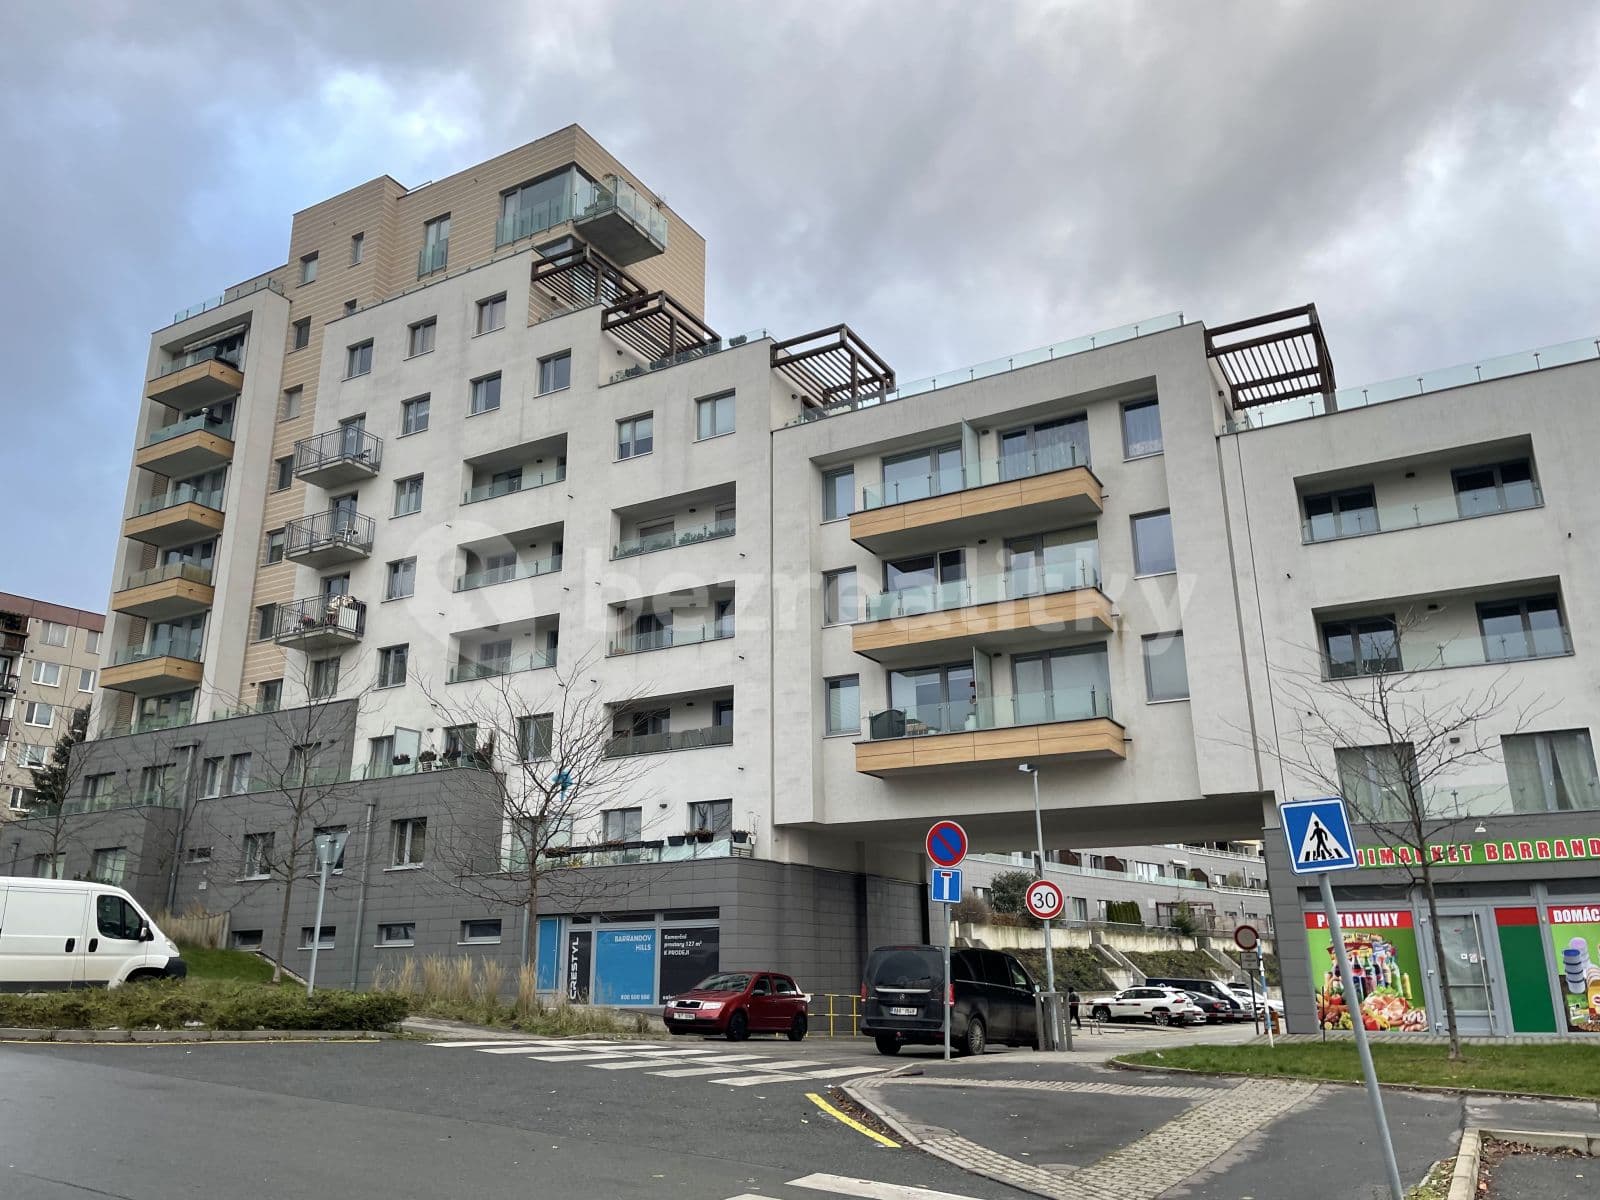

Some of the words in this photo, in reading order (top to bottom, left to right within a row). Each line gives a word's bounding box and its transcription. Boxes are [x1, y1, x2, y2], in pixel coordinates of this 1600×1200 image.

[1033, 892, 1056, 908] 30
[1316, 913, 1399, 928] PTRAVINY
[1553, 907, 1600, 923] DOMÁC
[570, 937, 579, 1000] CRESTYL
